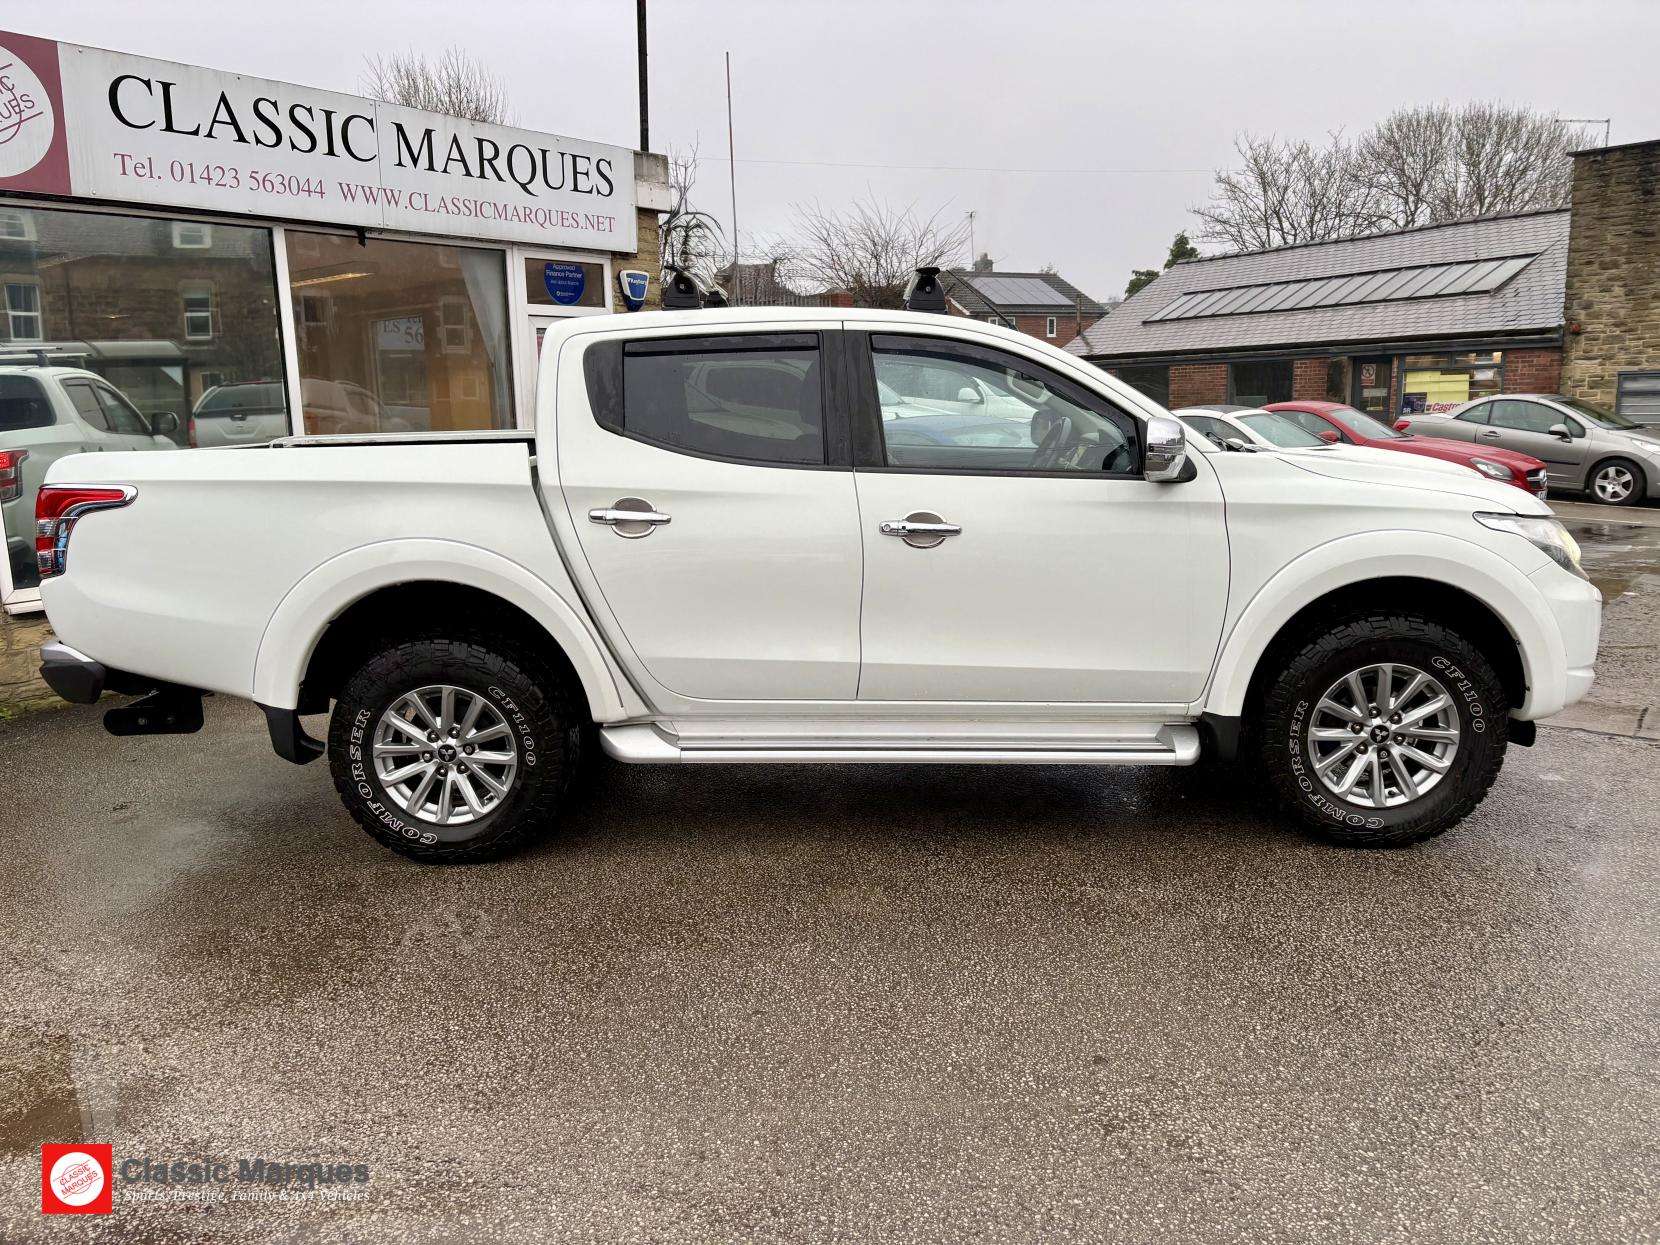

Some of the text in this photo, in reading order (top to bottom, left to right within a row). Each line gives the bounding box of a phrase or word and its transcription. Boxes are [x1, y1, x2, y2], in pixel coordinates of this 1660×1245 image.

[108, 74, 615, 198] CLASSIC MARQUES
[113, 152, 616, 233] Tel. 01423 563044 WWW.CLASSICMARQUES.NET
[545, 269, 583, 279] Finance Partner
[488, 686, 536, 766] CF1100
[1431, 656, 1486, 733] CF1100
[350, 709, 438, 845] COMFORSER
[1289, 700, 1385, 829] COMFORSER
